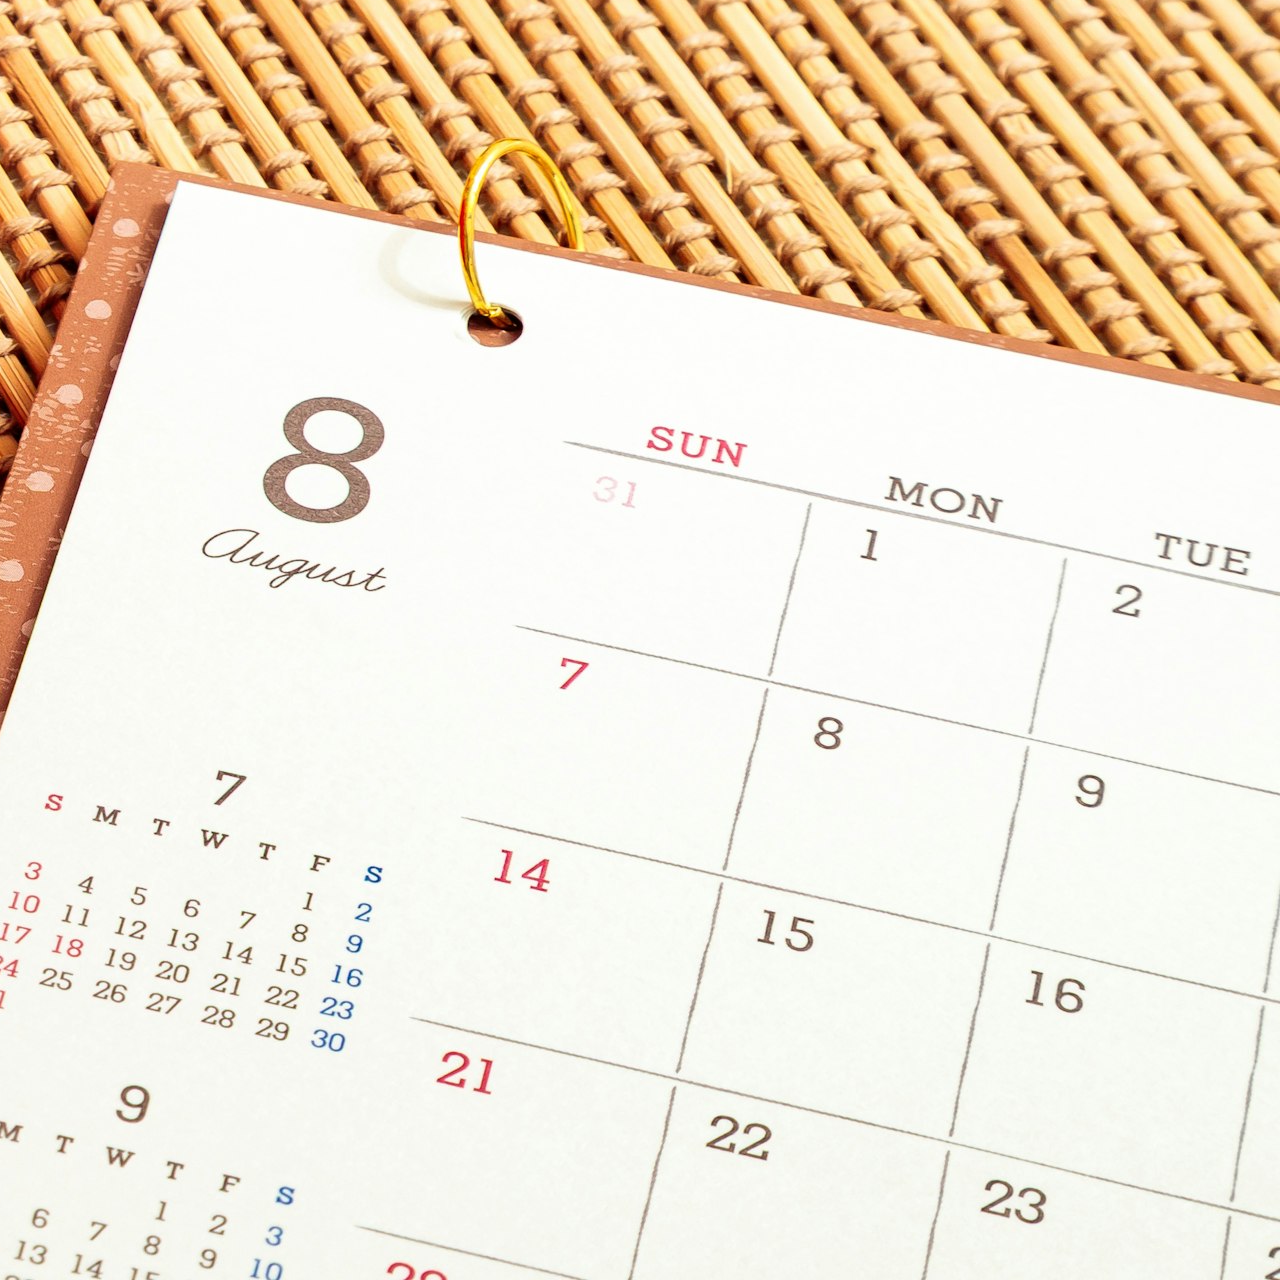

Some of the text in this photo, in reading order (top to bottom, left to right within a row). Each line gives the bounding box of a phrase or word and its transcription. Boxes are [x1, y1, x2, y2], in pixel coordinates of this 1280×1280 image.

[262, 396, 386, 524] 8
[645, 425, 1252, 577] SUN MON TUE
[201, 528, 387, 593] August
[592, 474, 1143, 618] 31 1 2
[559, 656, 1106, 809] 7 8 9
[213, 769, 248, 807] 7
[44, 793, 384, 884] S M T W T F S
[7, 890, 364, 988] 10 11 12 13 14 15 16
[23, 861, 364, 954] 3 4 5 6 7 8 9
[301, 891, 373, 923] 1 2
[493, 848, 1086, 1014] 14 15 16
[38, 967, 74, 992] 25
[91, 979, 129, 1004] 26
[144, 991, 183, 1015] 27
[200, 1004, 237, 1029] 28
[254, 1017, 291, 1042] 29
[310, 1028, 347, 1053] 30
[51, 934, 85, 959] 18
[104, 947, 138, 972] 19
[154, 959, 191, 984] 20
[209, 972, 242, 997] 21
[263, 985, 301, 1010] 22
[319, 996, 355, 1021] 23
[115, 1084, 151, 1124] 9
[435, 1050, 1048, 1225] 21 22 23
[55, 1134, 75, 1155] T
[105, 1145, 137, 1169] W
[166, 1160, 185, 1181] T
[218, 1173, 242, 1194] F
[274, 1185, 296, 1206] S
[14, 1239, 49, 1266] 13
[70, 1253, 104, 1280] 14
[31, 1207, 51, 1229] 6
[89, 1220, 108, 1242] 7
[142, 1234, 162, 1257] 8
[198, 1248, 218, 1270] 9
[249, 1257, 284, 1280] 10
[154, 1200, 284, 1247] 1 2 3
